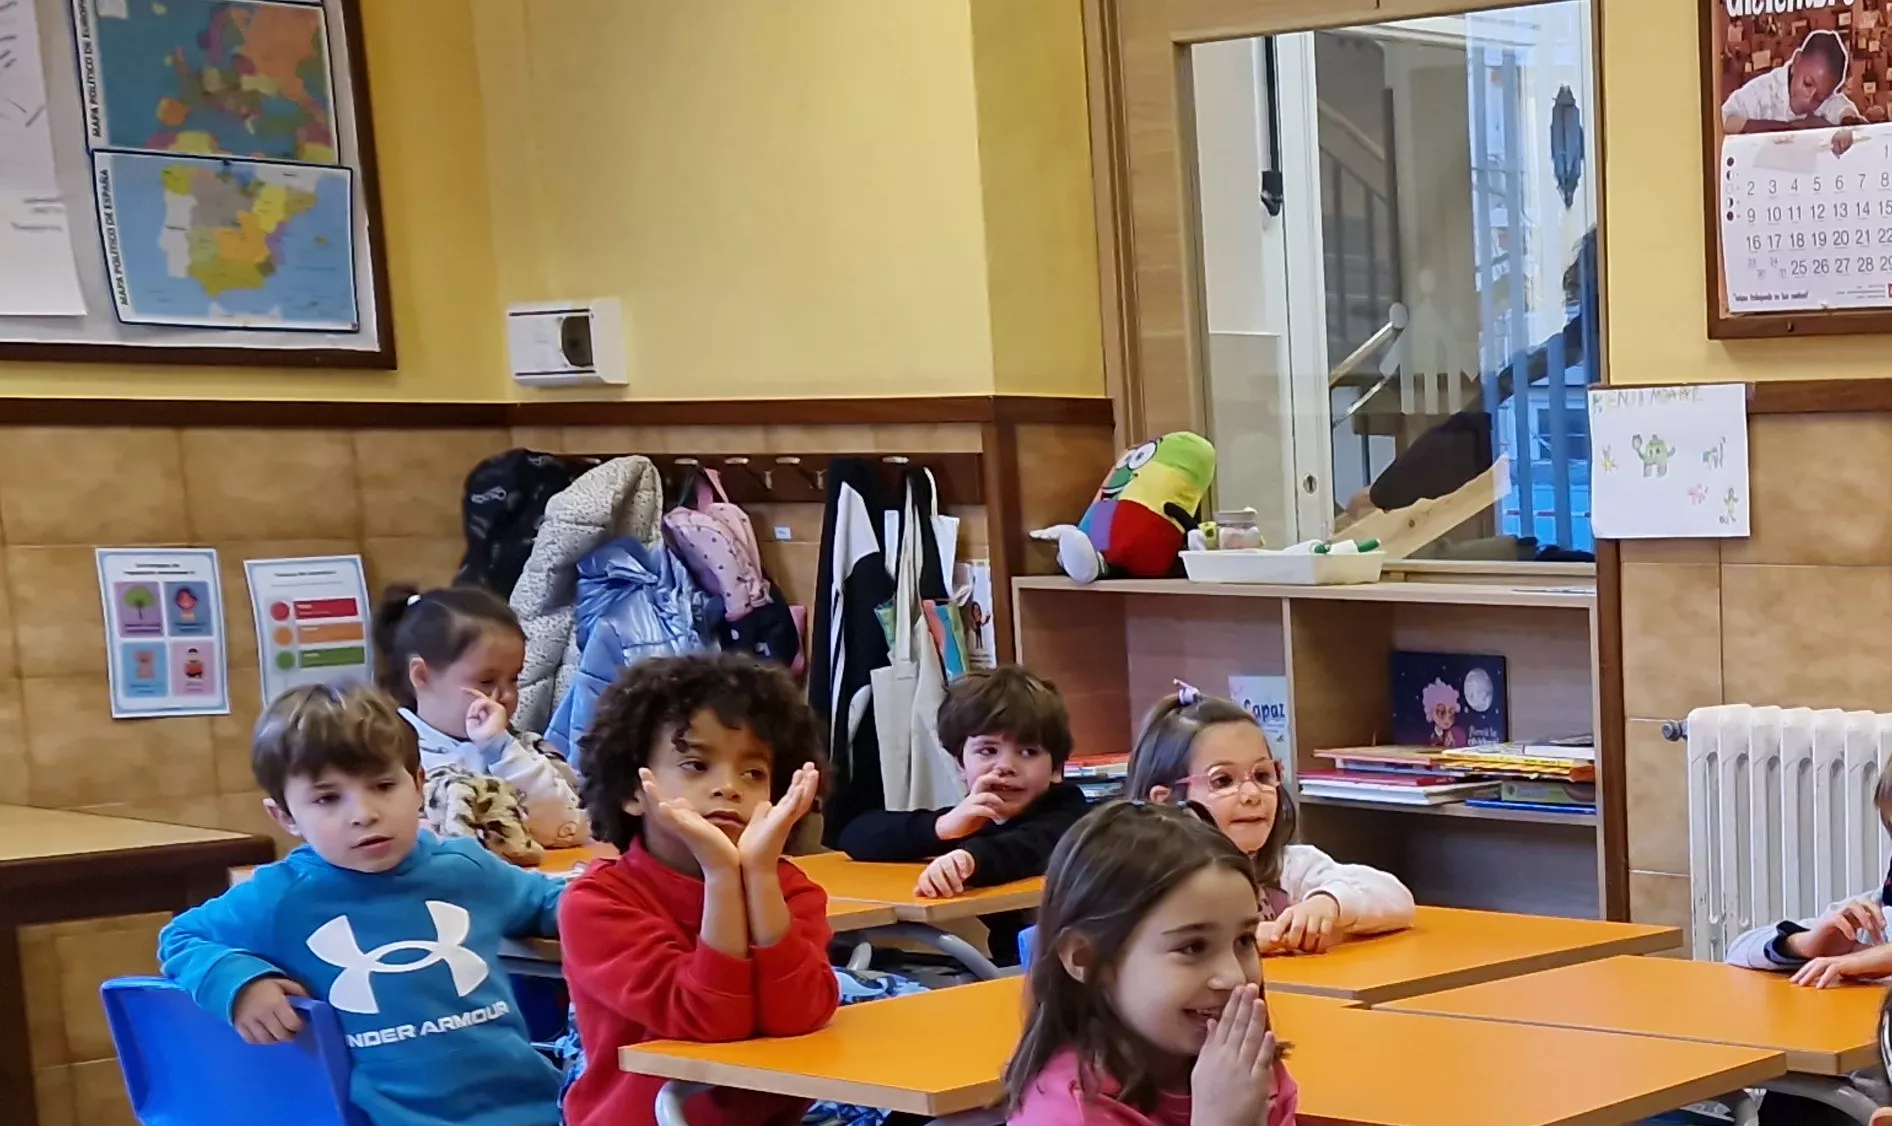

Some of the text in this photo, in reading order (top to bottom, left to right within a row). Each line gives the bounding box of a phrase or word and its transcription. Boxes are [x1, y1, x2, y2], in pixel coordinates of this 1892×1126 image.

[90, 107, 101, 137] MAPA
[99, 169, 113, 210] ESPAÑA
[1747, 171, 1890, 196] 2 3 4 5 6 7 8
[104, 211, 115, 226] DE
[1747, 207, 1755, 223] 9
[1767, 206, 1781, 222] 10
[1789, 205, 1802, 221] 11
[1810, 203, 1825, 220] 12
[1833, 202, 1848, 218] 13
[1856, 201, 1870, 217] 14
[1746, 234, 1761, 250] 16
[1767, 233, 1782, 249] 17
[1790, 232, 1805, 248] 18
[1811, 231, 1827, 247] 19
[1832, 230, 1849, 246] 20
[1855, 229, 1870, 245] 21
[1790, 259, 1807, 275] 25
[1812, 258, 1829, 274] 26
[1835, 257, 1850, 273] 27
[1857, 256, 1874, 272] 28
[116, 277, 129, 306] MAPA
[346, 1000, 510, 1048] NDER ARMOUR
